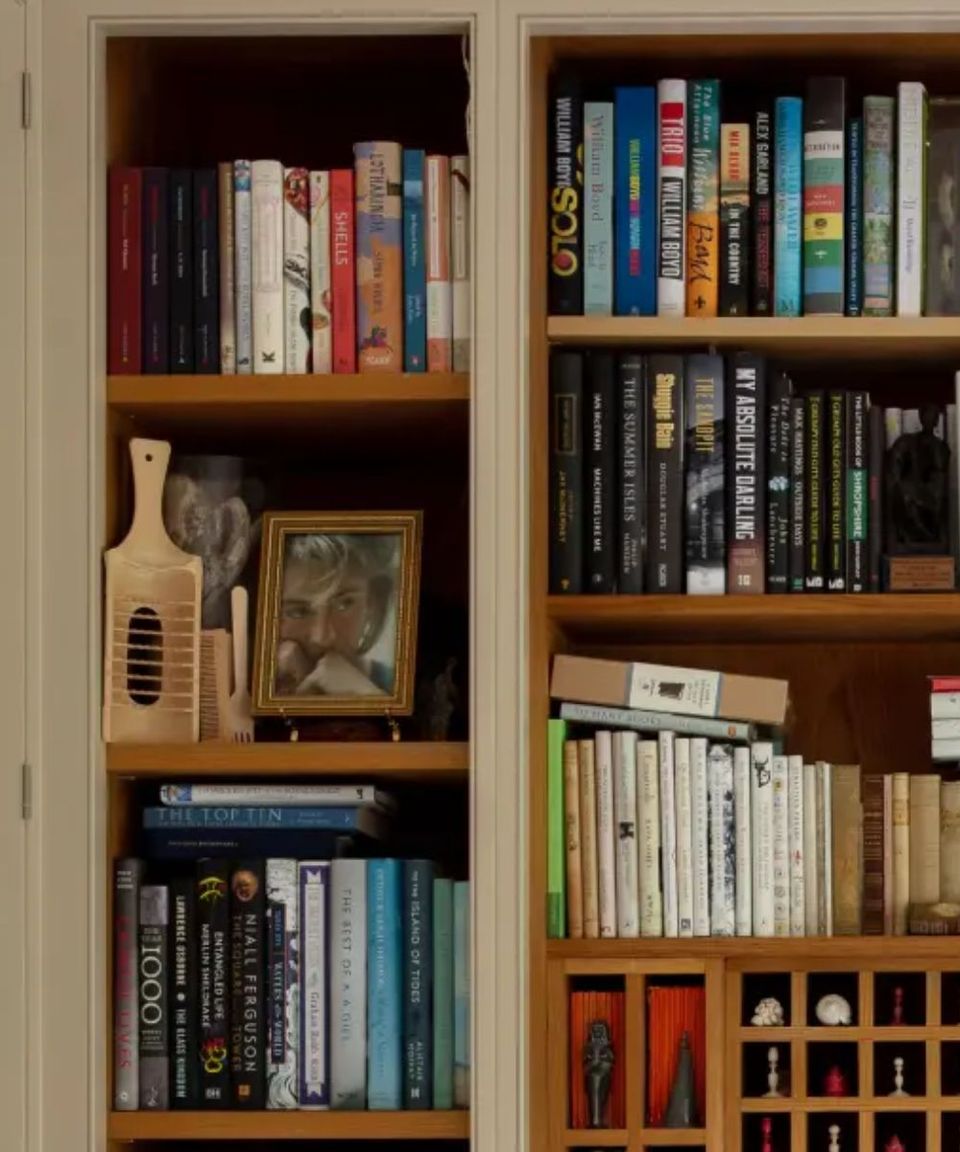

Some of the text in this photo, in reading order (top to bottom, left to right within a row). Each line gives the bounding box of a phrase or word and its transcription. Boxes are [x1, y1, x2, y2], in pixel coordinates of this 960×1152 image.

[556, 97, 572, 153] WILLIAM
[591, 115, 605, 222] William Boyd
[661, 118, 684, 154] TRIO
[756, 112, 769, 195] ALEX GARLAND
[335, 212, 347, 265] SHELLS
[551, 187, 578, 276] SOLO
[661, 181, 681, 278] WILLIAM BOYD
[728, 208, 740, 285] IN THE COUNTRY
[624, 378, 636, 521] THE SUMMER ISLES
[695, 377, 714, 453] THE SANDPIT
[735, 368, 756, 540] MY ABSOLUTE DARLING
[593, 393, 601, 552] IAN McEWAN MACHINES LIKE ME
[659, 462, 667, 552] DOUGLAS STUART
[795, 408, 803, 546] MAX HASTINGS OUTSIDE DAYS
[853, 471, 863, 537] SHROPSHIRE
[201, 924, 210, 1027] MERLIN SHELDRAKE
[214, 931, 225, 1019] ENTANGLED LIFE
[342, 889, 352, 976] THE BEST OF
[411, 901, 421, 1003] ISLAND OF TIDES
[141, 944, 163, 1024] 1000
[176, 895, 187, 1098] LAWRENCE OSBORNE THE GLASS KINGDOM
[233, 915, 242, 1072] THE SQUARE TOWER
[244, 914, 257, 1072] NIALL FERGUSON
[309, 991, 319, 1027] Graham
[275, 1021, 284, 1056] WORLD
